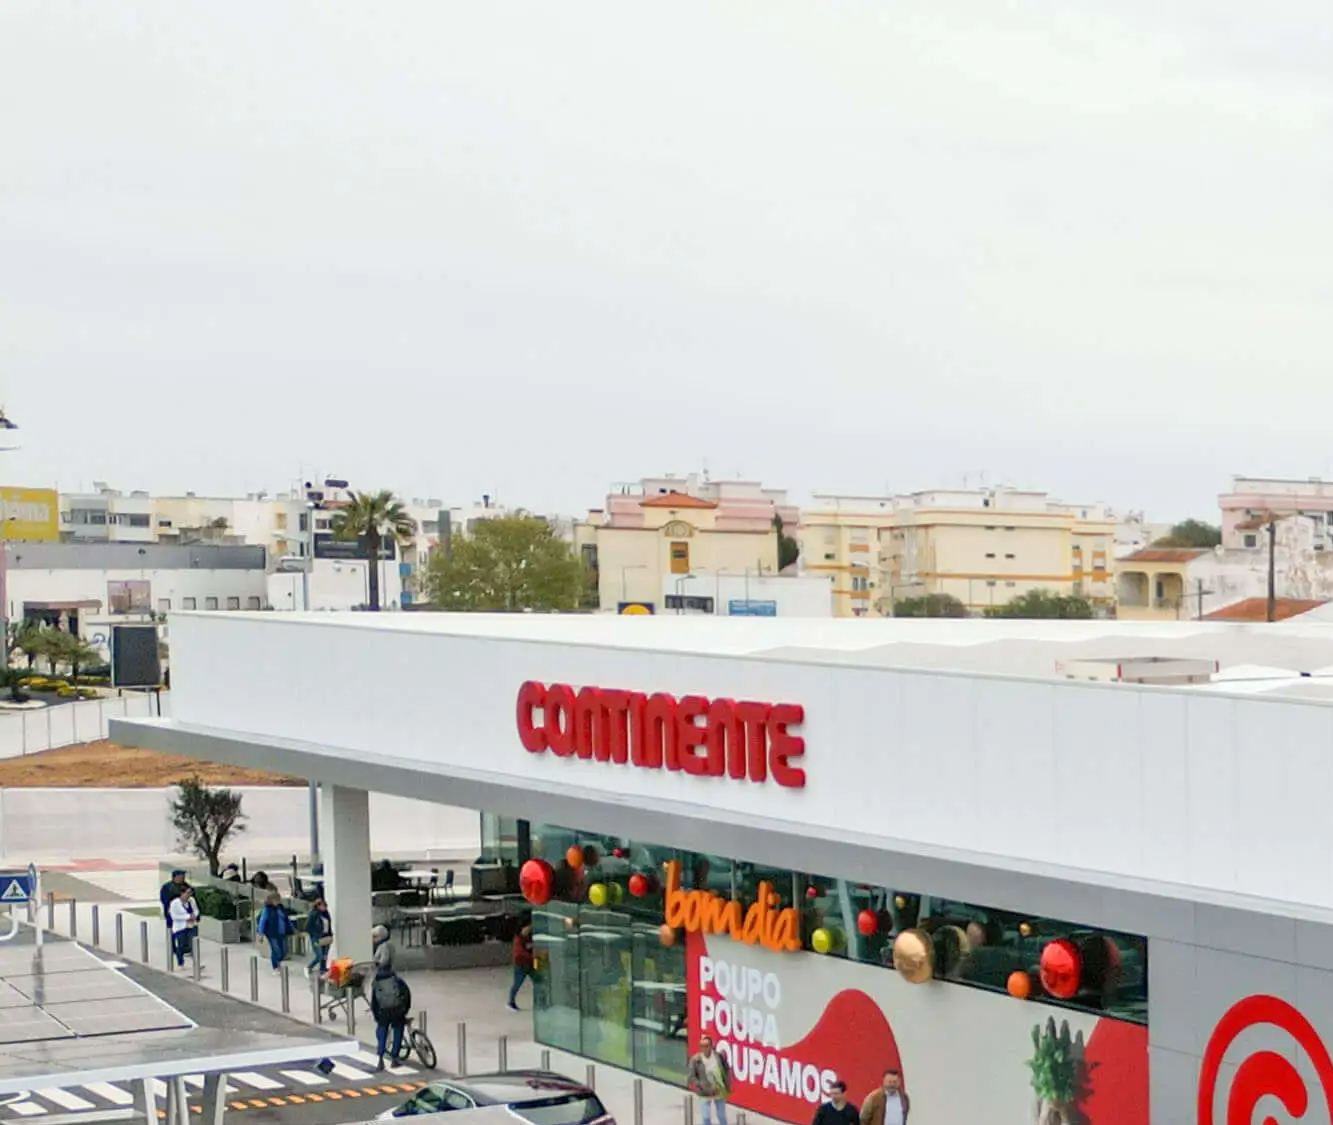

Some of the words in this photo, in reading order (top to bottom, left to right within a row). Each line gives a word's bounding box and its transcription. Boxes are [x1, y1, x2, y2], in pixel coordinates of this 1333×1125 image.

[516, 680, 806, 788] CONTINENTE
[700, 956, 780, 1009] POUPO
[700, 995, 780, 1050] POUPA
[702, 1036, 837, 1103] OUPAMOS
